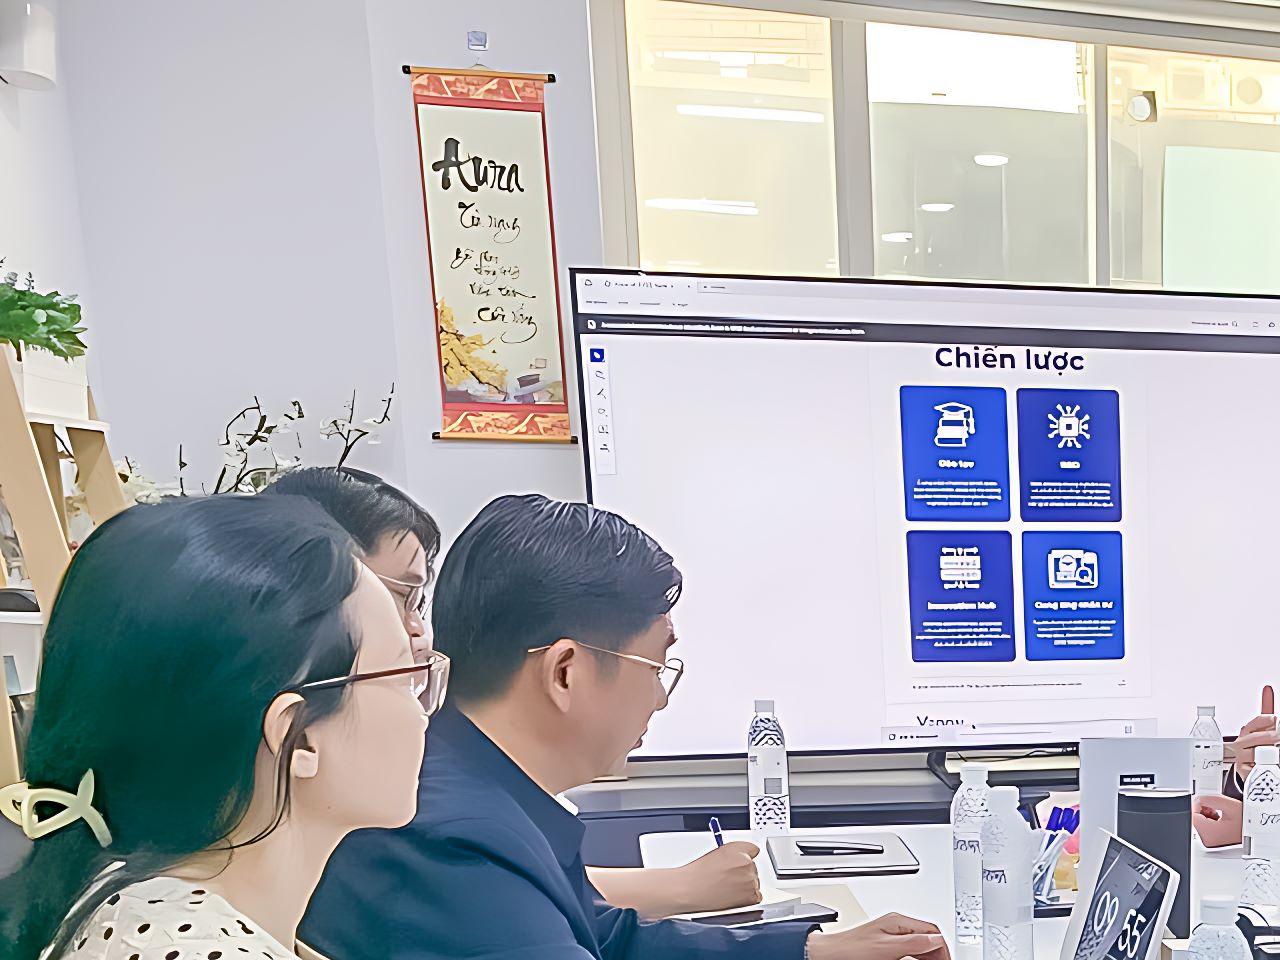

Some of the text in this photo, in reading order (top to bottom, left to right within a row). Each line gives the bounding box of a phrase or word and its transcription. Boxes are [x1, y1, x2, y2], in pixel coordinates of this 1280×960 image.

[432, 137, 525, 193] Aura
[935, 346, 1085, 376] Chiến lược
